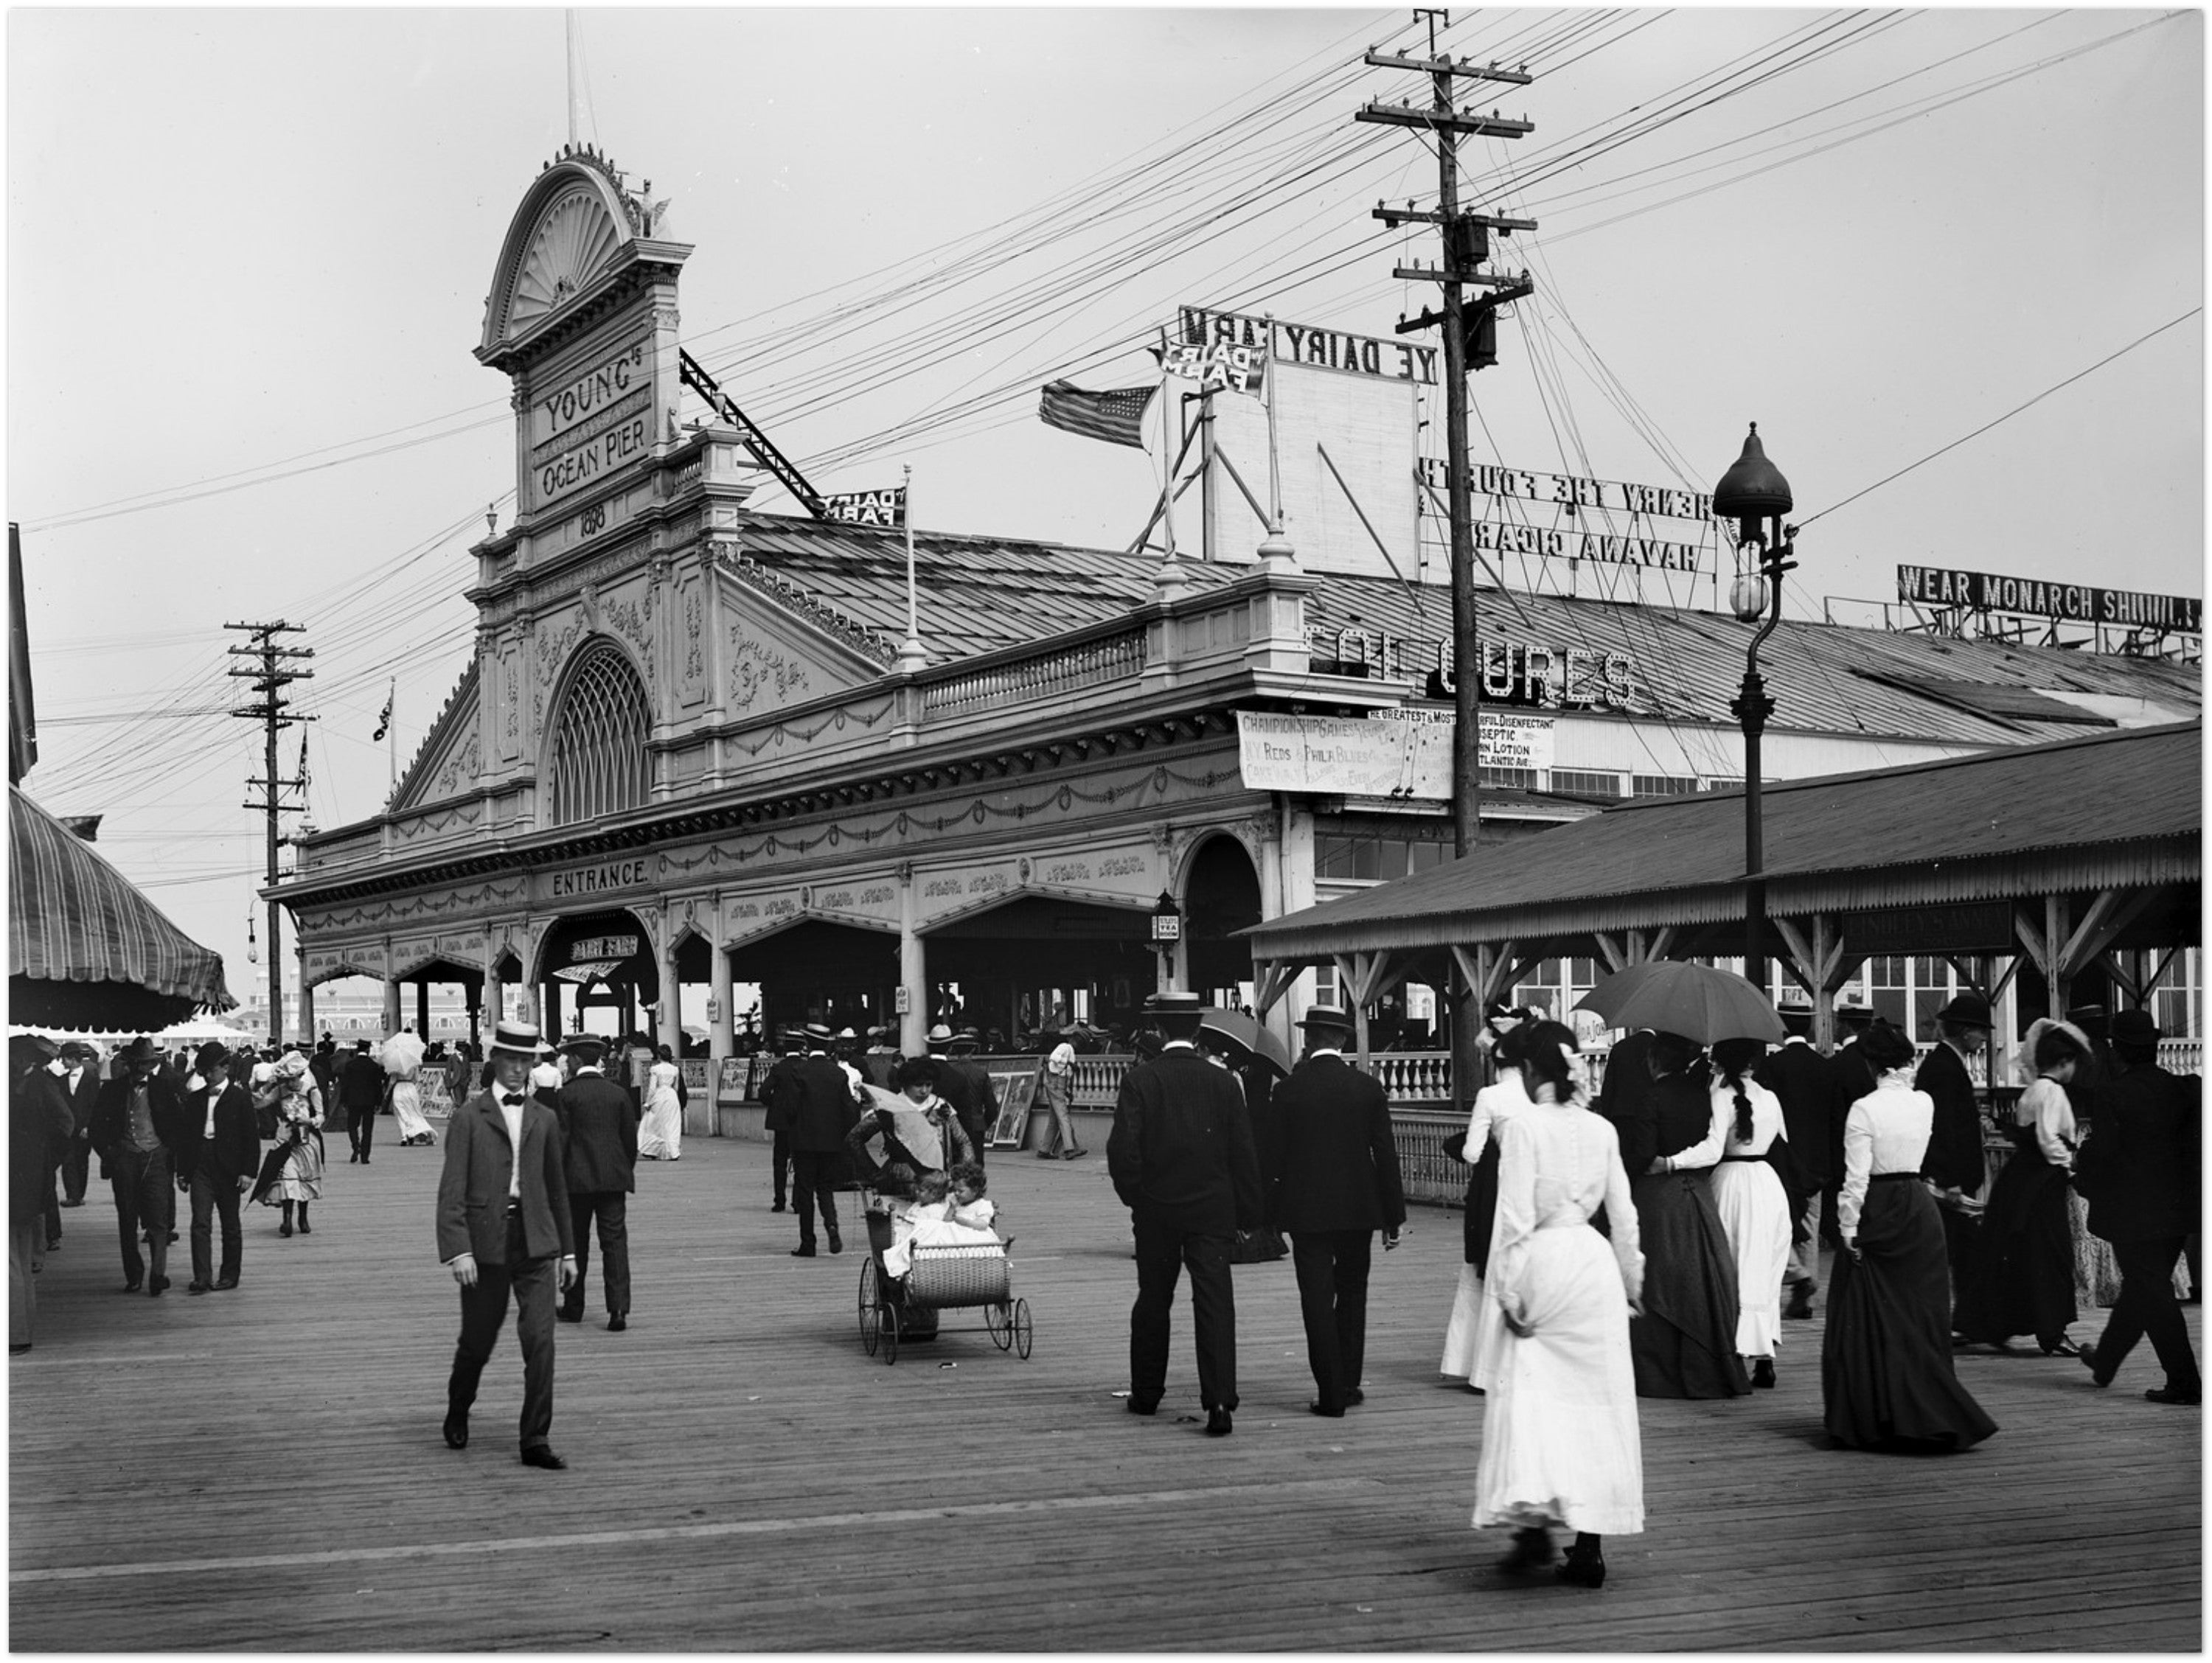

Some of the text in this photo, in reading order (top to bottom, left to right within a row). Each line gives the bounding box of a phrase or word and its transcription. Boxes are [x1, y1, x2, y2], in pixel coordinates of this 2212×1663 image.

[543, 419, 644, 496] OCEAN PIER
[580, 504, 605, 537] 1898
[1900, 565, 1971, 604] WEAR
[1982, 574, 2093, 618] MONARCH
[1242, 715, 1319, 735] CHAMPIONSHIP
[1382, 709, 1427, 722] GREATEST
[1433, 711, 1457, 724] MOST
[1478, 715, 1499, 726] RFUL
[1478, 728, 1516, 741] SEPTIC
[1263, 742, 1292, 761] REDS
[1494, 740, 1530, 756] LOTION
[1479, 754, 1514, 766] TLANTIC
